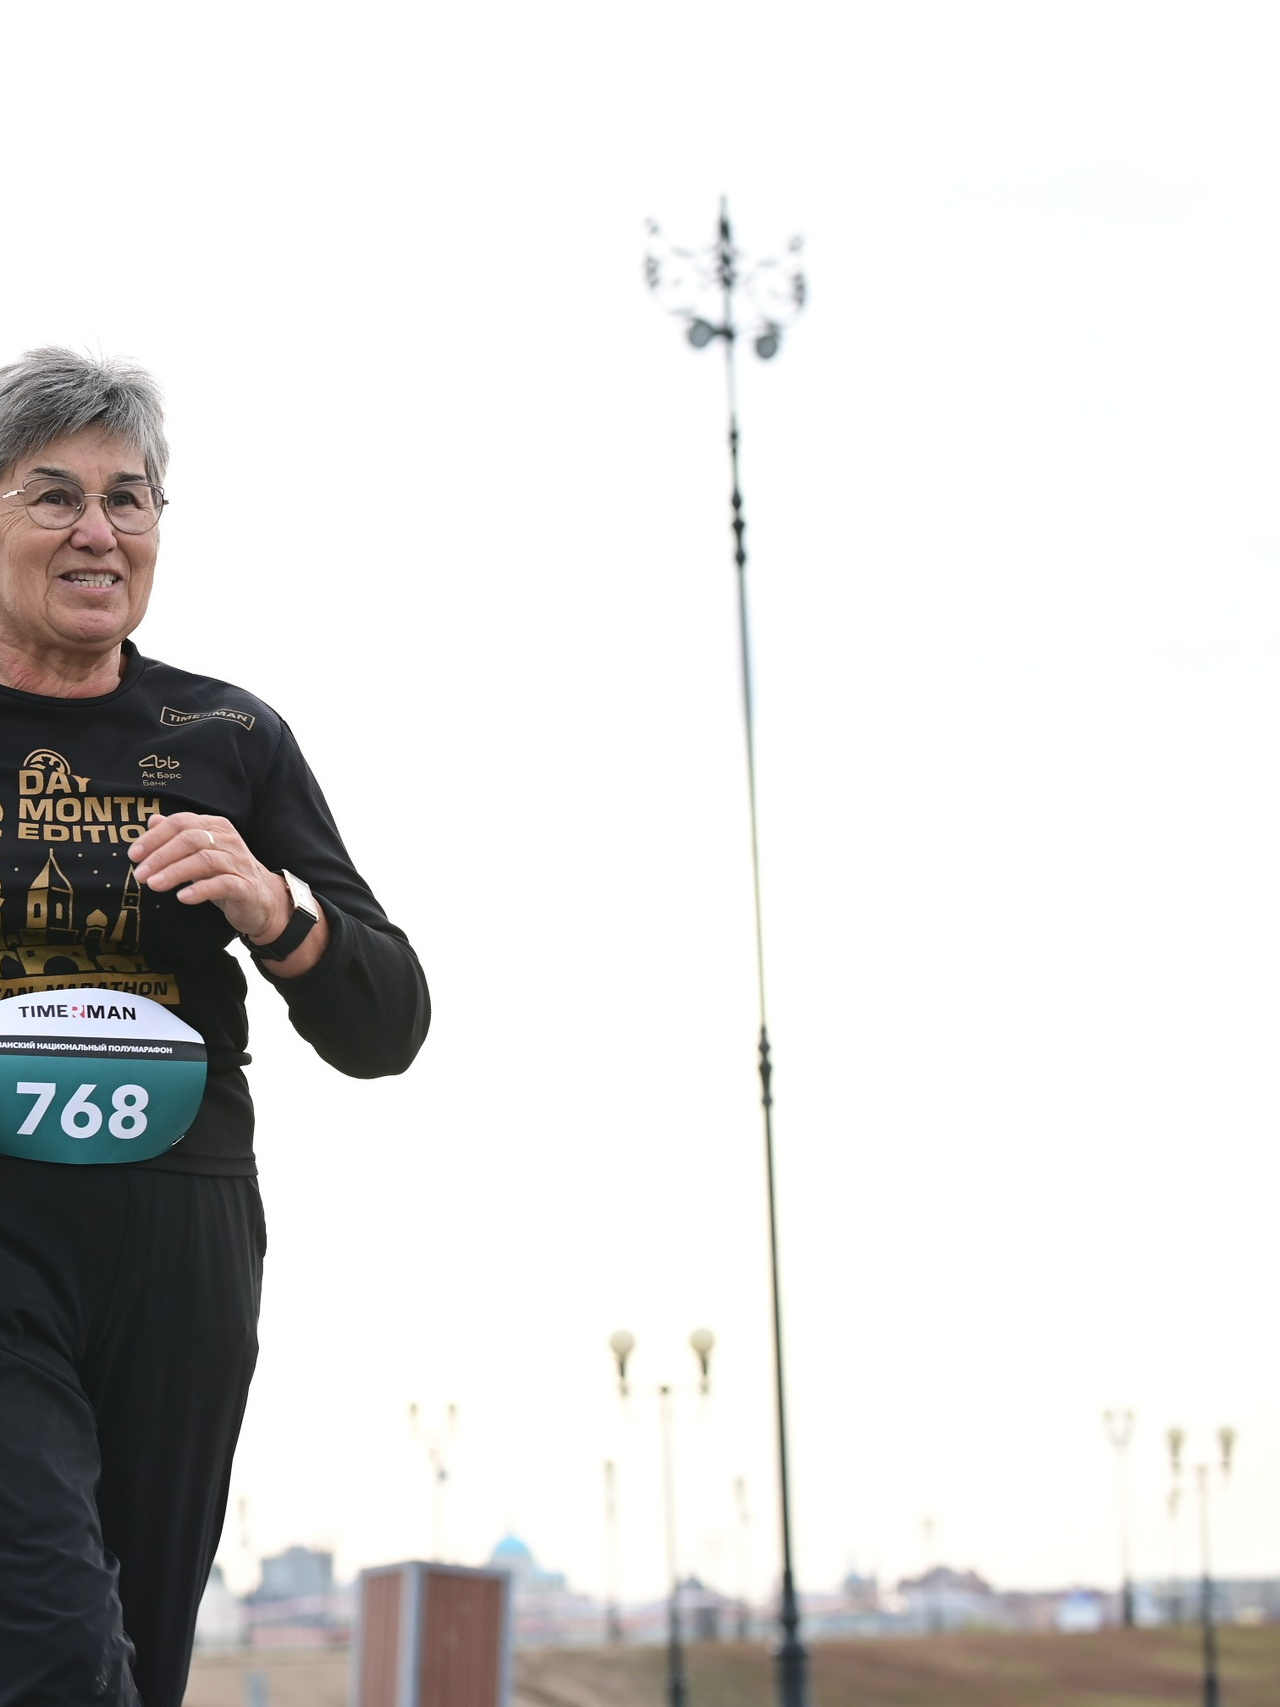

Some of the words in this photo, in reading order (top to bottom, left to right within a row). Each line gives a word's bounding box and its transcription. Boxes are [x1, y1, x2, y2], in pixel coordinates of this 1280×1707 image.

[19, 769, 91, 796] DAY
[141, 770, 156, 778] Ак
[19, 796, 162, 822] MONTH
[17, 822, 147, 844] EDITIO
[37, 1043, 107, 1052] НАЦИОНАЛЬНЫЙ
[108, 1045, 173, 1054] ПОЛУМАРАФОН
[16, 1081, 150, 1140] 768
